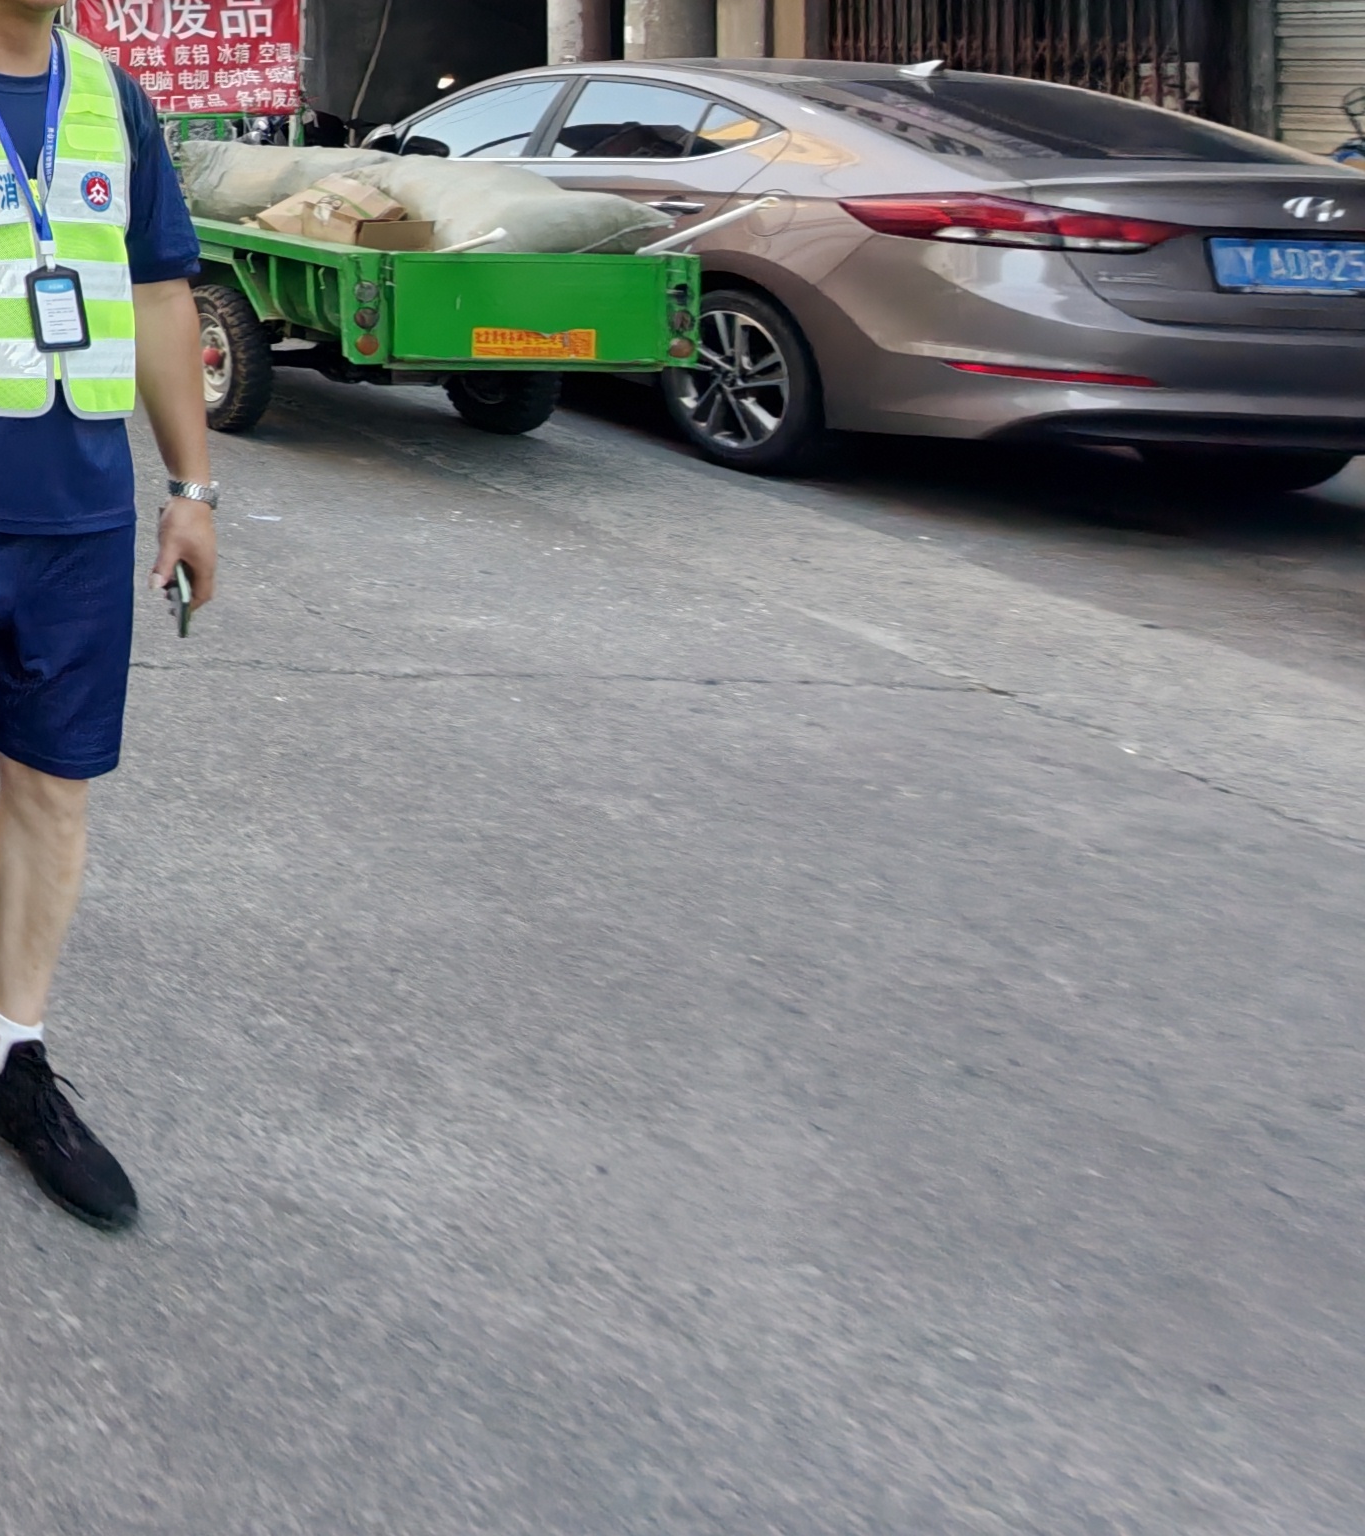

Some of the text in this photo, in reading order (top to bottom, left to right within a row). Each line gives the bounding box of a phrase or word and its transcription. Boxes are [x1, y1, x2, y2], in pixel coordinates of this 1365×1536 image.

[130, 46, 166, 67] 废铁
[174, 44, 210, 66] 废铝
[217, 43, 251, 64] 冰箱
[259, 42, 292, 63] 空调
[140, 70, 174, 91] 电脑
[178, 68, 210, 90] 电视
